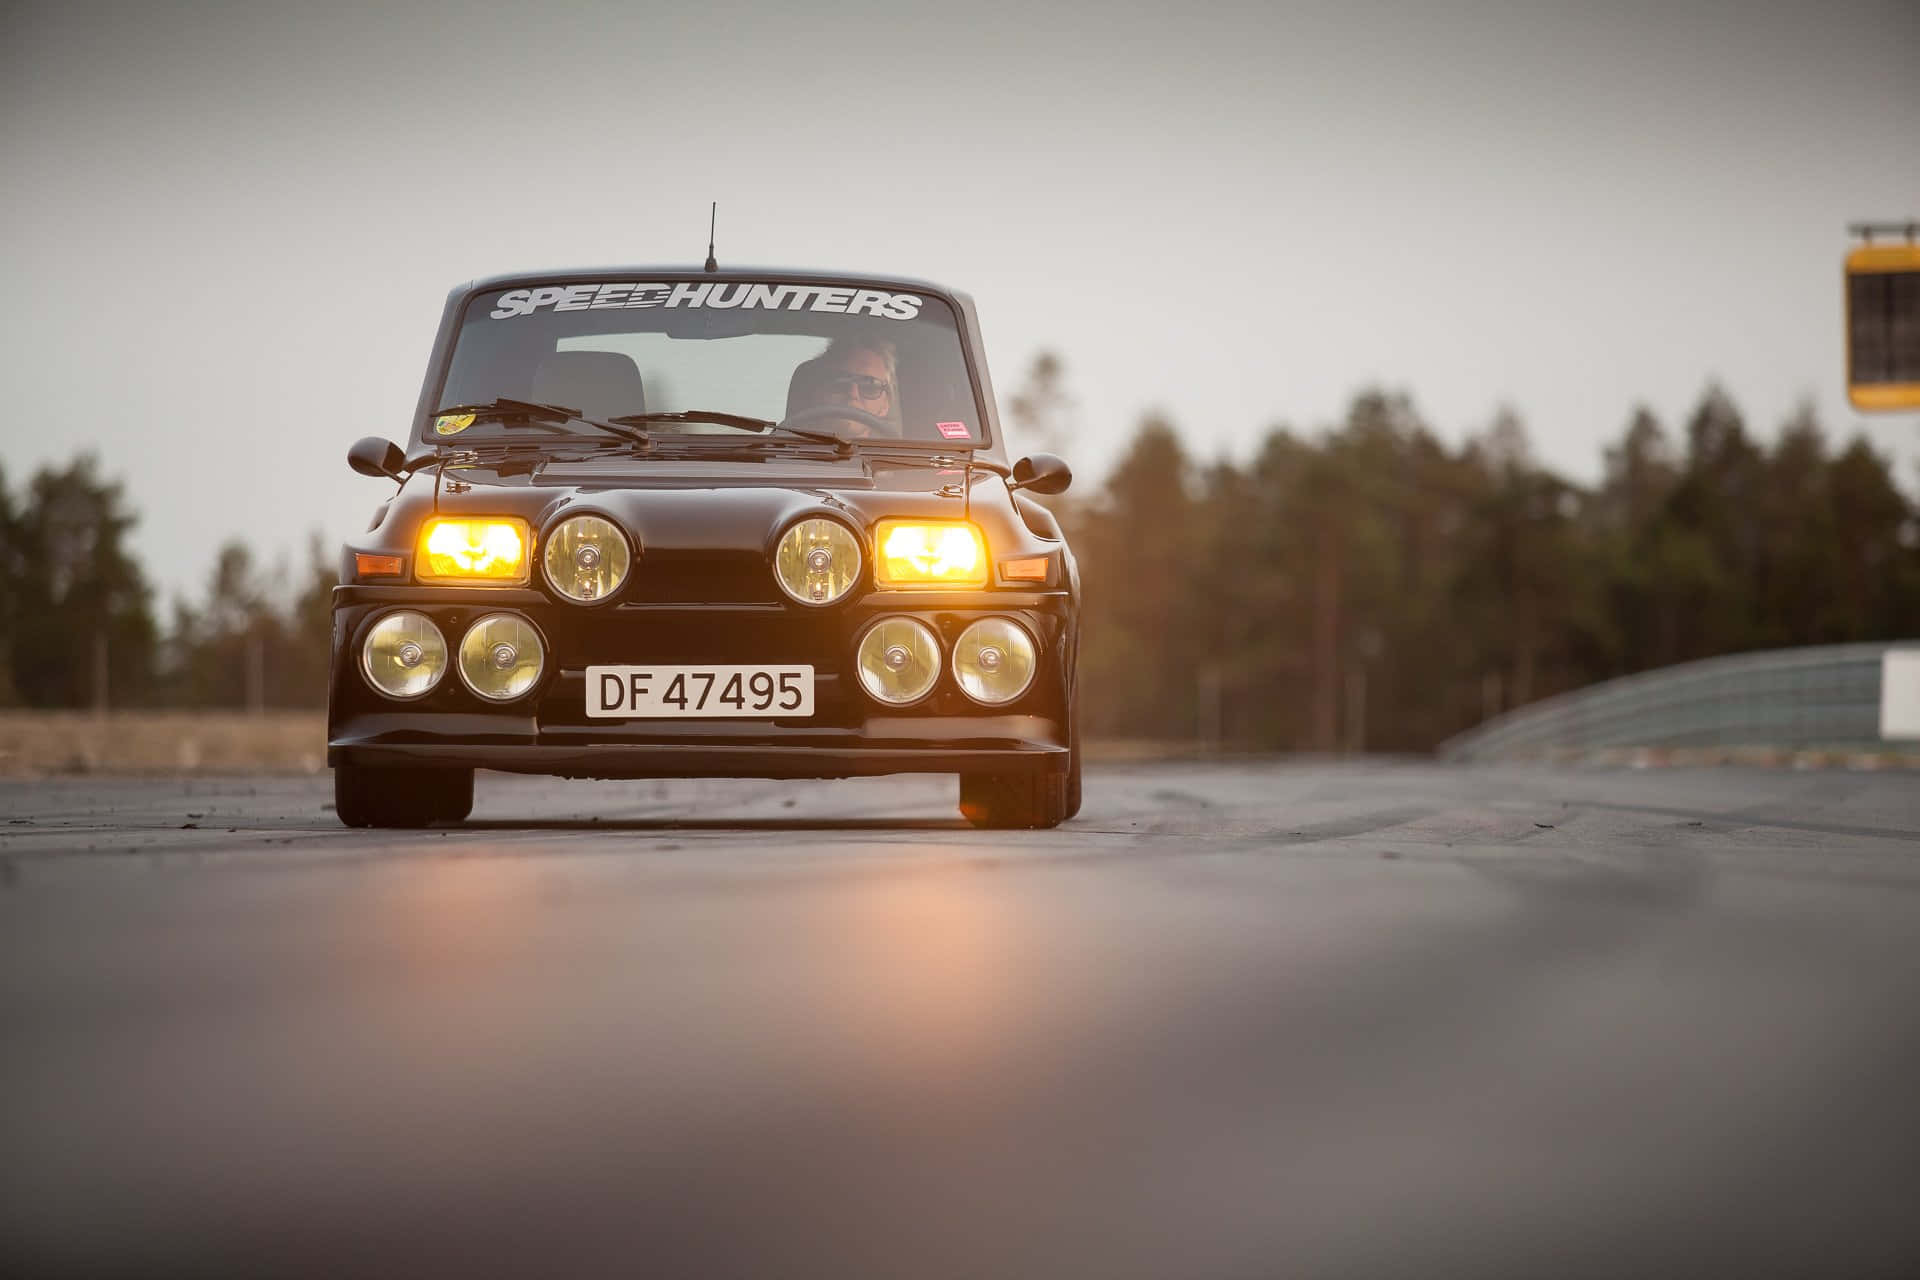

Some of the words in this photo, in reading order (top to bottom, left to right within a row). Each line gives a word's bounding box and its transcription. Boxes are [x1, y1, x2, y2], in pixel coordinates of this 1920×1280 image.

[489, 283, 922, 320] SPEEDHUNTERS
[600, 673, 653, 710] DF
[662, 671, 802, 710] 47495
